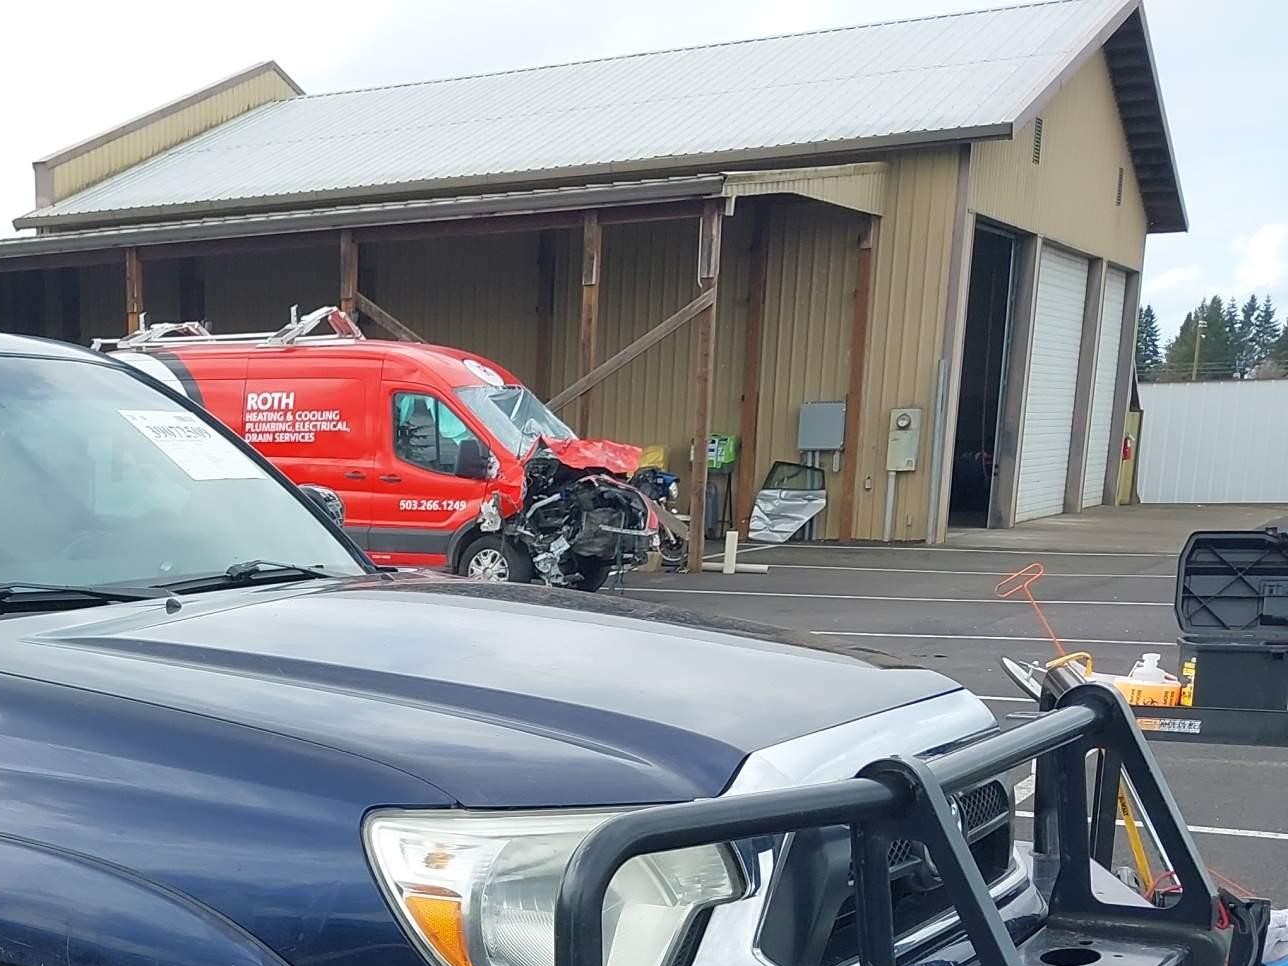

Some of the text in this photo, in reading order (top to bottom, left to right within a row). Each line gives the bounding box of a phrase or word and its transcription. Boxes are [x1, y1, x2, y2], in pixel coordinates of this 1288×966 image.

[246, 391, 295, 411] ROTH
[245, 410, 340, 422] HEATING & COOLING
[245, 432, 315, 443] DRAIN SERVICES
[399, 499, 467, 511] 503.266.1249
